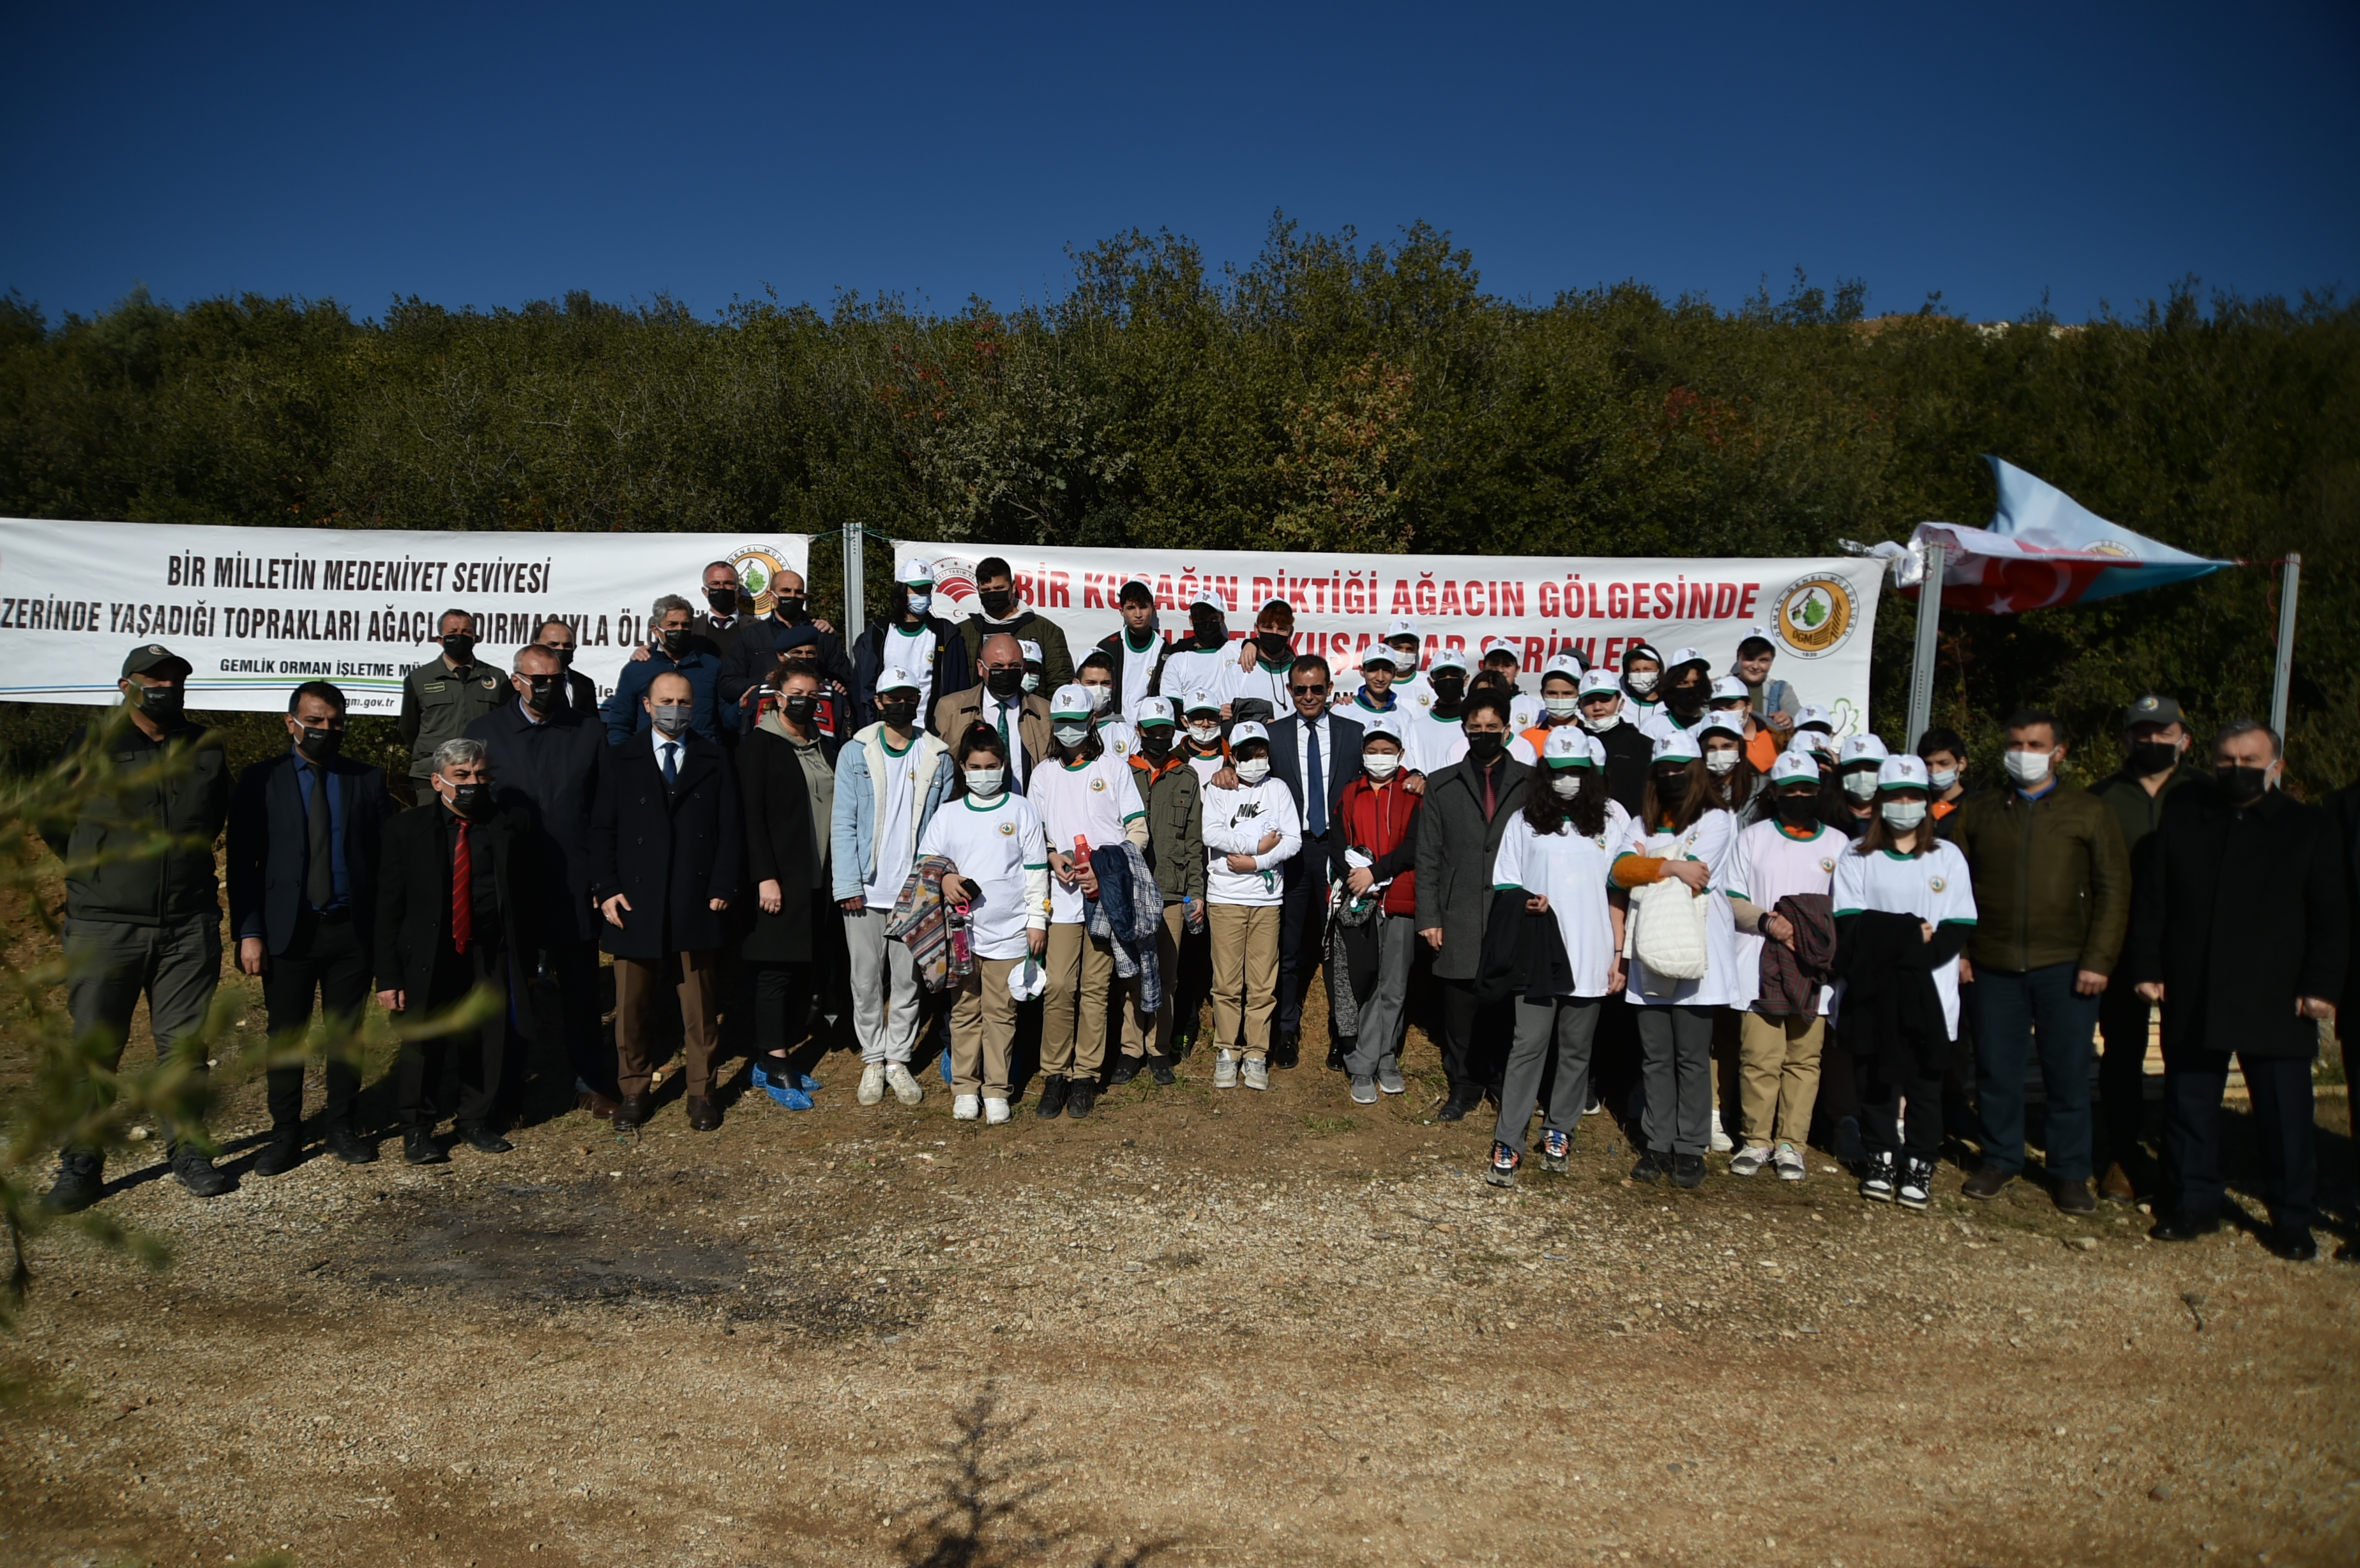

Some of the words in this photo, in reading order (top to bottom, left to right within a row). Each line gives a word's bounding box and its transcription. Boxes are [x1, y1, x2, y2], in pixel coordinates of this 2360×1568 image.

[167, 549, 205, 587] BİR
[213, 550, 315, 590] MİLLETİN
[322, 554, 448, 592] MEDENİYET
[451, 555, 551, 594] SEVİYESİ
[1014, 562, 1070, 608] BİR
[1252, 568, 1378, 615] DİKTİĞİ
[1390, 571, 1525, 617] AĞACIN
[1538, 573, 1761, 619] GÖLGESİNDE
[0, 593, 102, 632] ZERİNDE
[109, 599, 216, 638] YAŞADIĞI
[223, 607, 359, 641] TOPRAKLARI
[1792, 629, 1813, 645] OGM
[220, 657, 275, 674] GEMLİK
[279, 660, 331, 675] ORMAN
[336, 659, 394, 677] İŞLETME
[344, 697, 395, 709] gm.gov.tr
